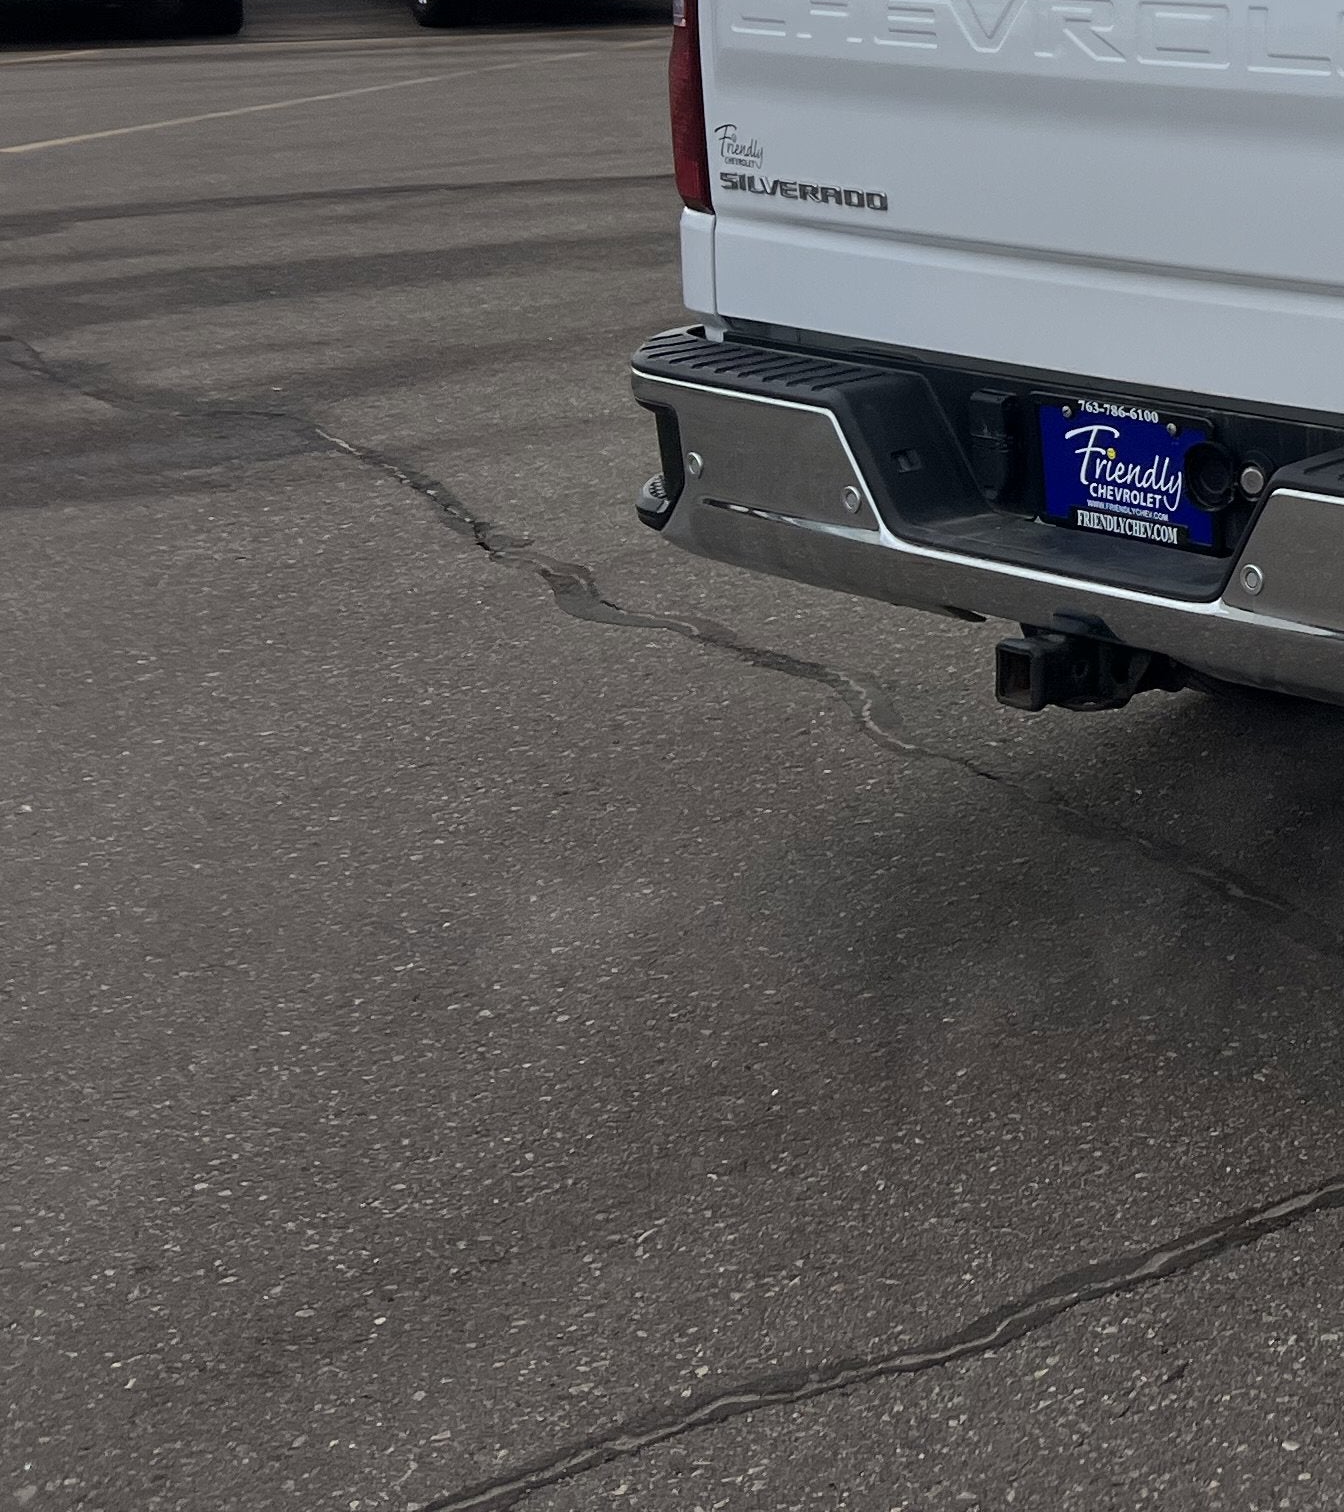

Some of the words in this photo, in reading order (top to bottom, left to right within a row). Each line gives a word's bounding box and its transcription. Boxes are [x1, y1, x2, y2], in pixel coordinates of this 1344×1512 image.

[714, 123, 764, 170] Friendly
[719, 171, 889, 211] SILVERADO
[1077, 399, 1160, 424] 763-786-6100
[1064, 424, 1183, 512] Friendly
[1089, 482, 1163, 509] CHEVROLET
[1076, 509, 1178, 545] FRIENDLYCHEV.COM
